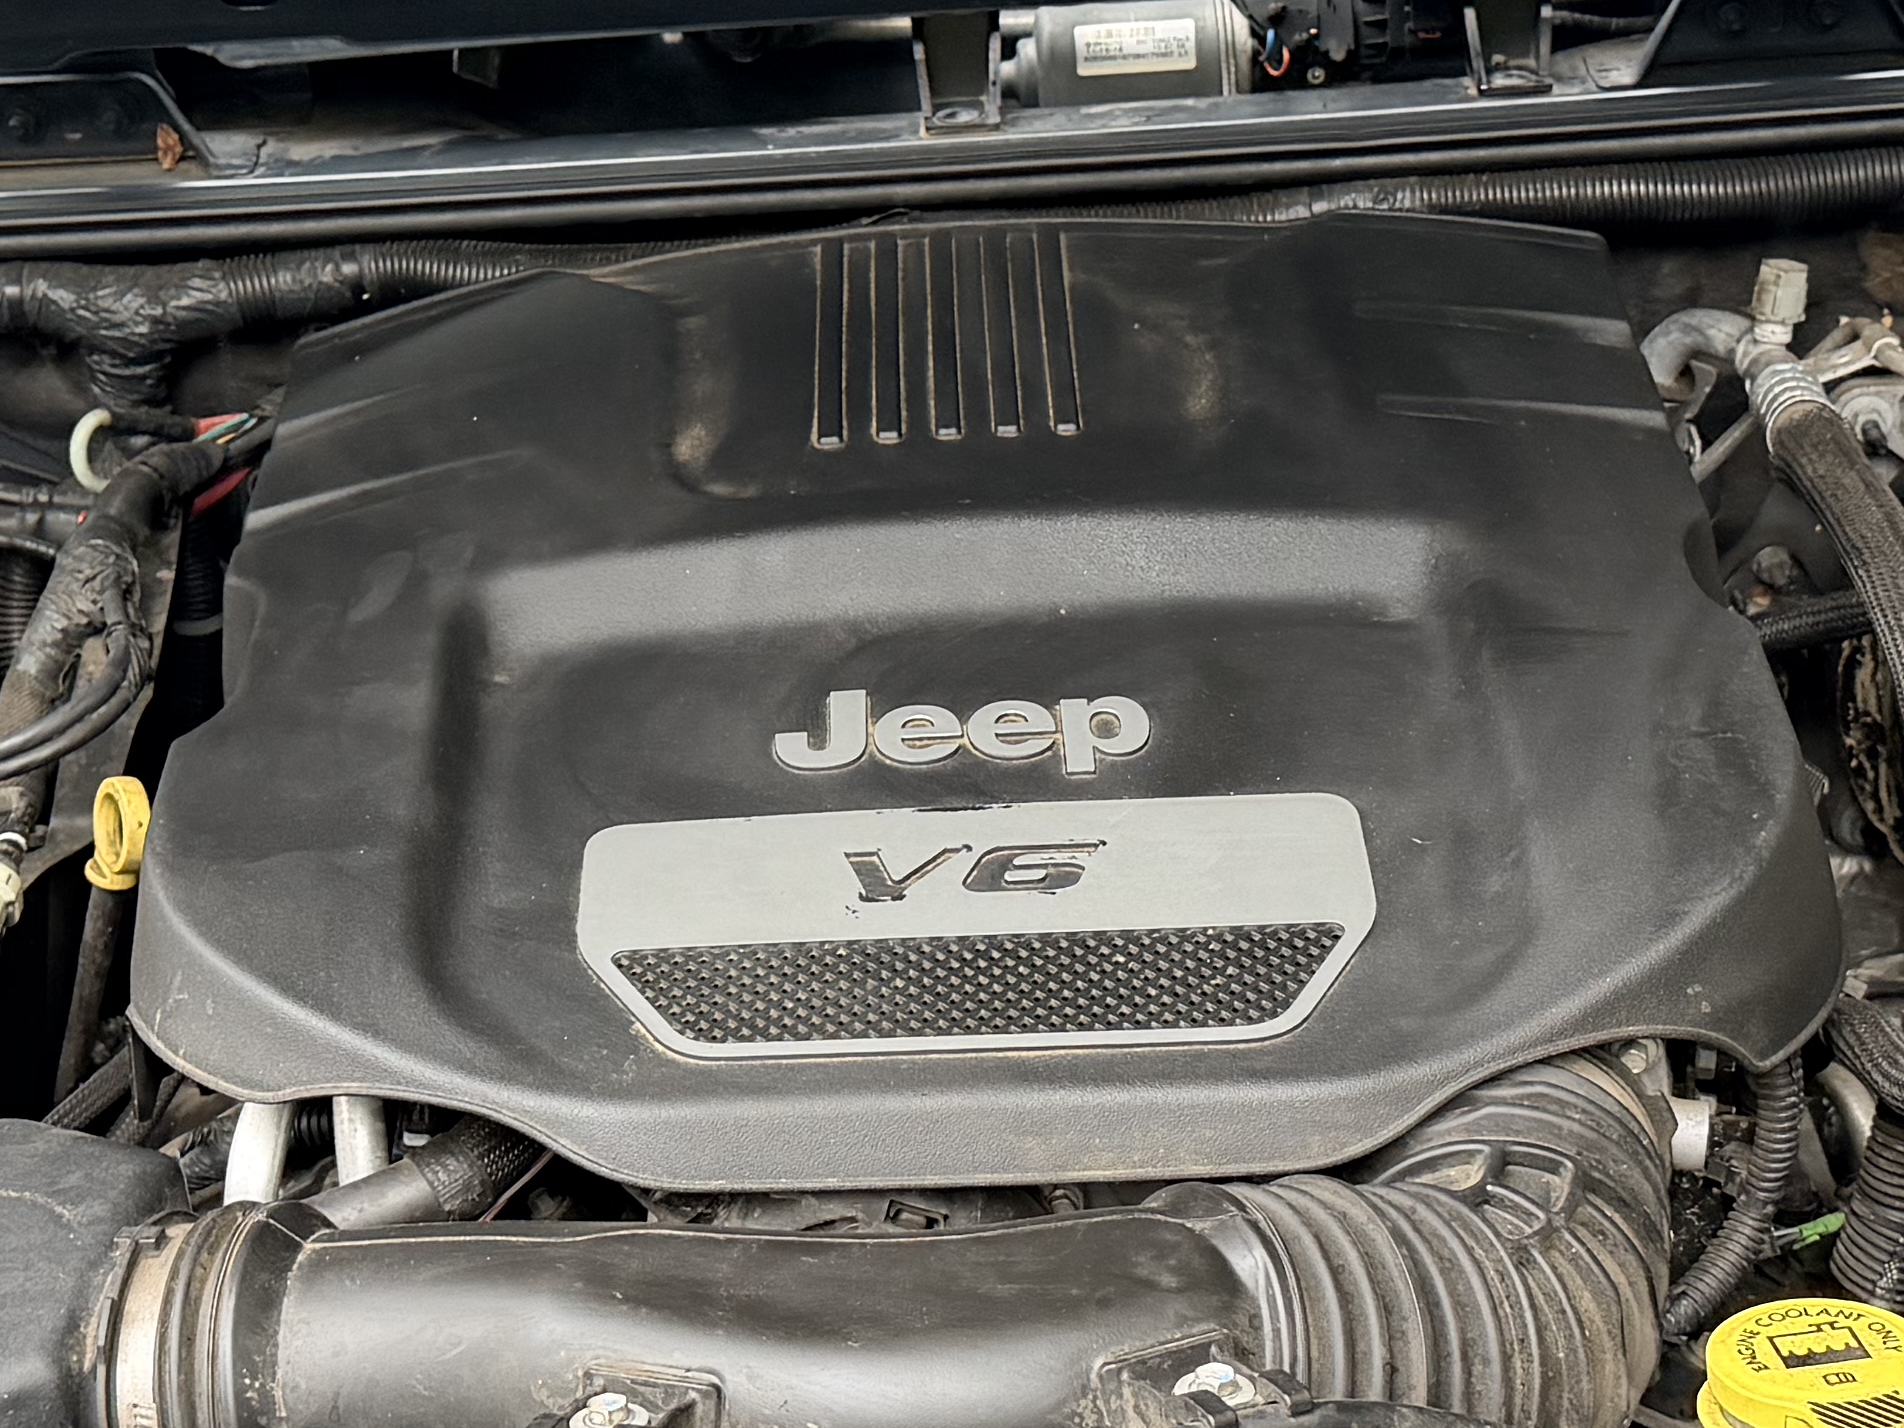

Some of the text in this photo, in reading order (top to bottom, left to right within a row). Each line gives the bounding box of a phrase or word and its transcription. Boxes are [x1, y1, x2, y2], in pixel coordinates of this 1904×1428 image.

[773, 689, 1151, 776] Jeep
[842, 839, 1107, 903] V6
[1736, 1307, 1903, 1373] ENGINE COOLANT ONLY
